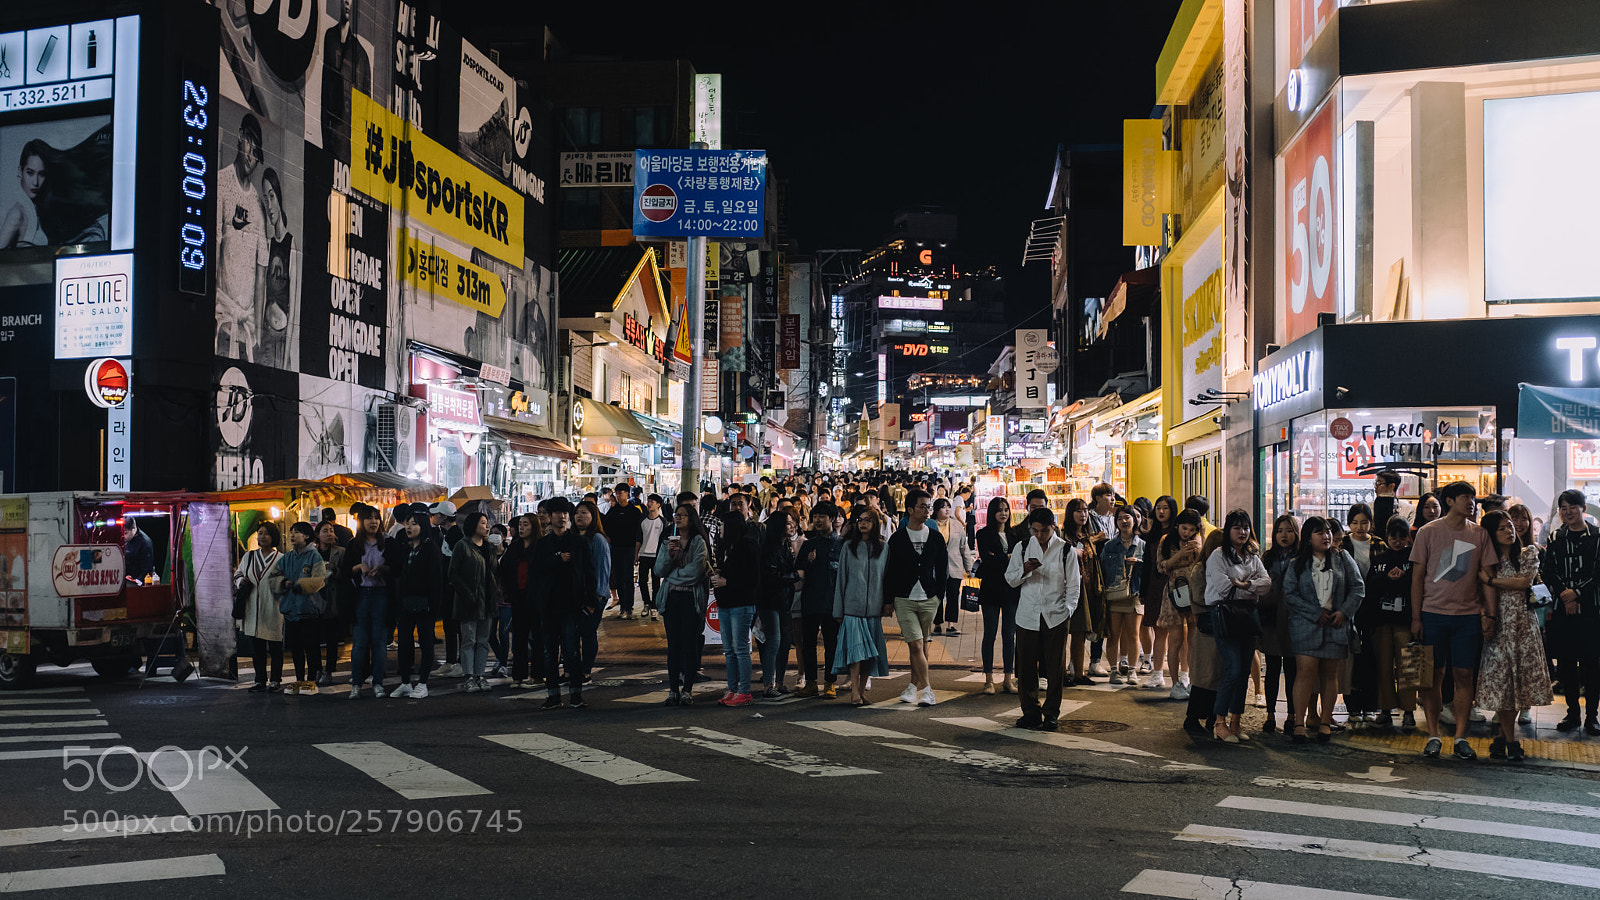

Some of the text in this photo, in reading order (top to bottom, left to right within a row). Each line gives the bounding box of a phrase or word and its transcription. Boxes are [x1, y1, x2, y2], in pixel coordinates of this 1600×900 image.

[463, 52, 504, 93] JDSPORTS.CO.KR
[3, 83, 87, 108] T.332.5211
[181, 79, 209, 271] 23:00:09
[640, 155, 694, 173] 어울마당로
[512, 162, 545, 205] HONGDAE
[643, 197, 674, 208] 진입금지
[684, 199, 758, 214] 금, 토, 일요일
[678, 219, 758, 231] 14:00~22:00
[418, 250, 491, 306] 홍대점 313m
[733, 272, 745, 281] 2F
[65, 279, 123, 307] ELLINE
[331, 276, 362, 316] OPEN
[2, 314, 42, 327] BRANCH
[91, 306, 128, 316] SALON
[1, 330, 15, 341] 입구
[329, 312, 381, 358] HONGDAE
[785, 317, 797, 361] 보드게임
[903, 343, 929, 356] DVD
[1556, 336, 1600, 382] T
[328, 350, 359, 385] OPEN
[1253, 351, 1314, 411] TONYMOLY
[1362, 423, 1425, 441] FABRIC
[77, 569, 120, 587] KEBAB HOUSE
